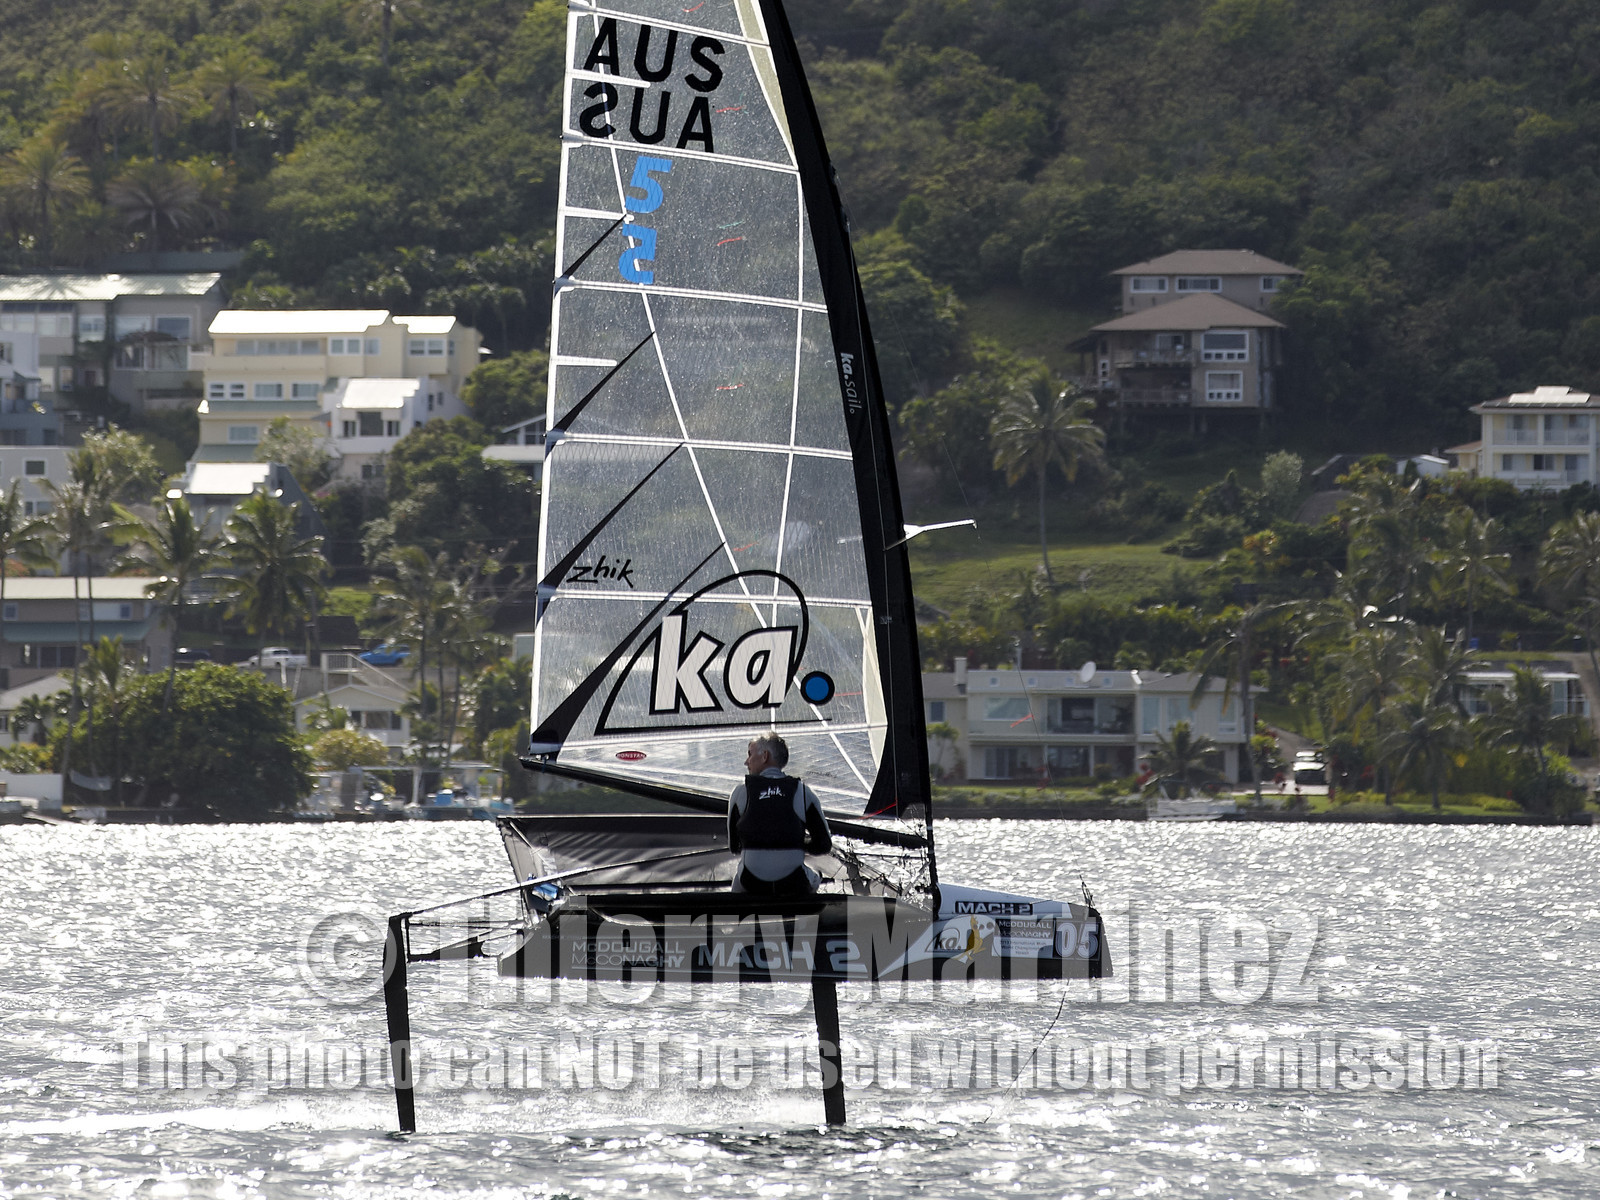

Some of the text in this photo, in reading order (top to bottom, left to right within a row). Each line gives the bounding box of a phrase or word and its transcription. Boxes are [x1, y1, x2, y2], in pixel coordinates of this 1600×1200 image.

[583, 17, 725, 92] AUS
[625, 156, 672, 214] 5
[566, 555, 633, 588] zhik
[957, 902, 1031, 915] MACH 2
[572, 941, 686, 954] McDOUGALL
[698, 940, 868, 973] MACH 2
[1055, 922, 1099, 959] 05
